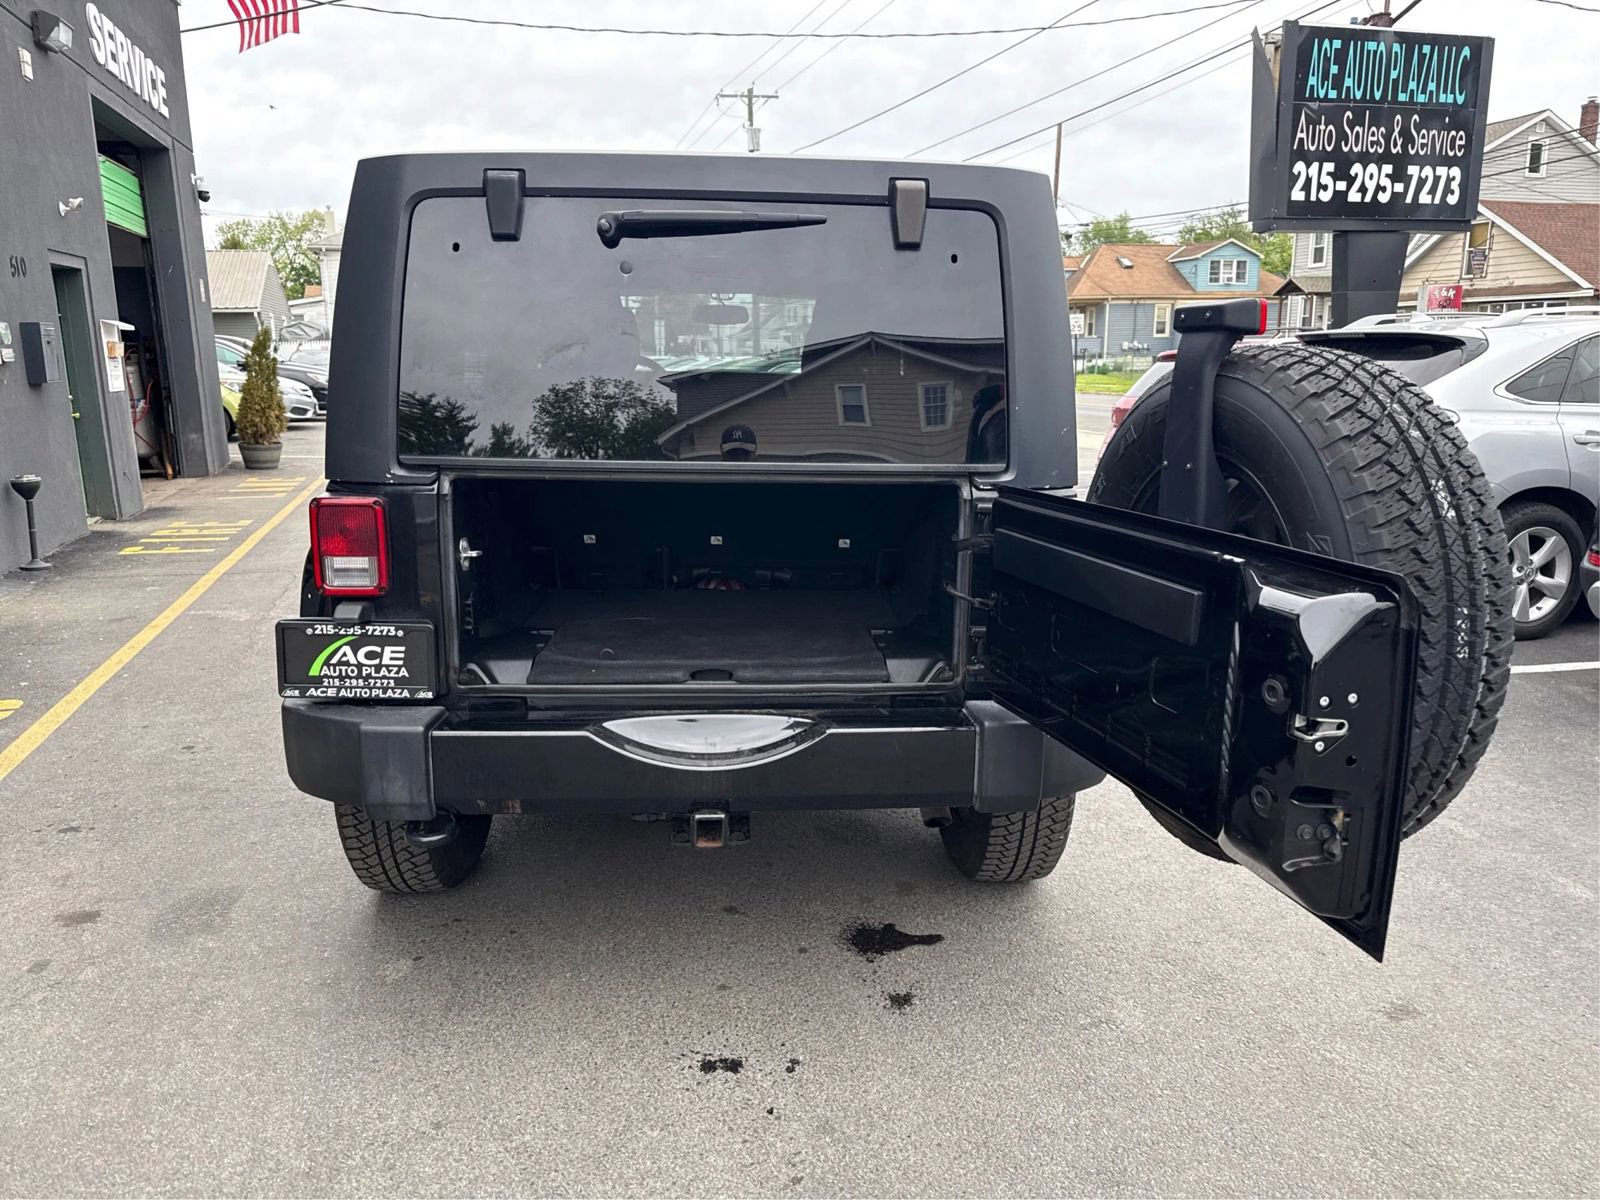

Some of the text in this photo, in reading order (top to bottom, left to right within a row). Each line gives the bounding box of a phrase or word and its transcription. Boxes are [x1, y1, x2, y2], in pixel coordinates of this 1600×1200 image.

[86, 3, 169, 119] SERVICE
[1305, 38, 1342, 99] ACE
[1342, 40, 1386, 101] AUTO
[1293, 107, 1466, 157] Auto Sales & Service
[1290, 160, 1462, 206] 215-295-7273
[9, 254, 27, 278] 510
[1071, 324, 1082, 332] 25
[117, 520, 254, 555] FIRE
[329, 645, 406, 665] ACE
[320, 666, 409, 677] AUTO PLAZA
[322, 678, 395, 686] 215-295-7273
[305, 688, 410, 698] ACE AUTO PLAZA
